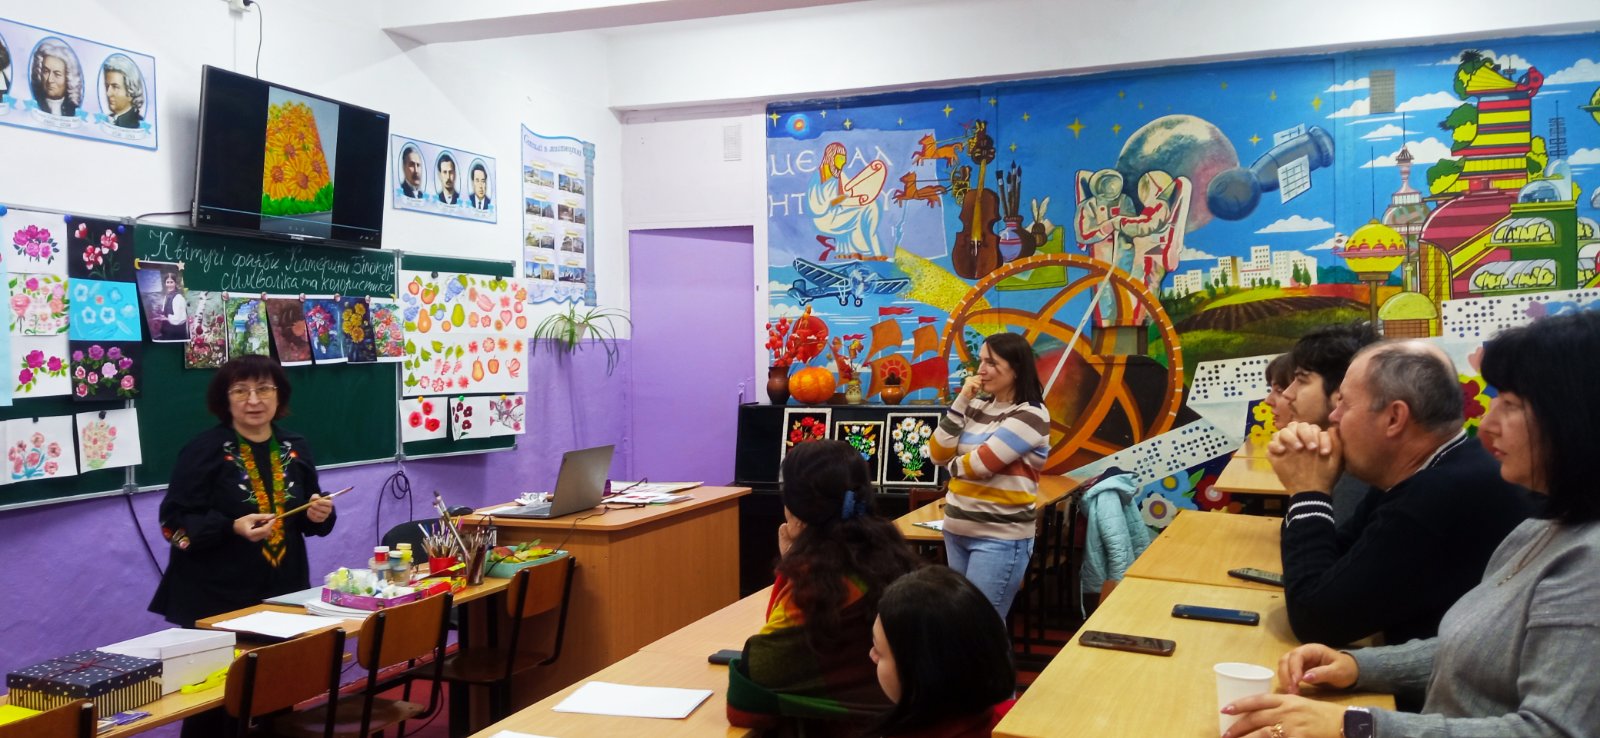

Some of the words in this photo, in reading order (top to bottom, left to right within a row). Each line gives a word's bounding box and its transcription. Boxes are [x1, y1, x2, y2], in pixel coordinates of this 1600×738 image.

[232, 251, 280, 279] фарби
[221, 271, 299, 290] символіка
[302, 277, 318, 291] та
[321, 277, 393, 297] колористика
